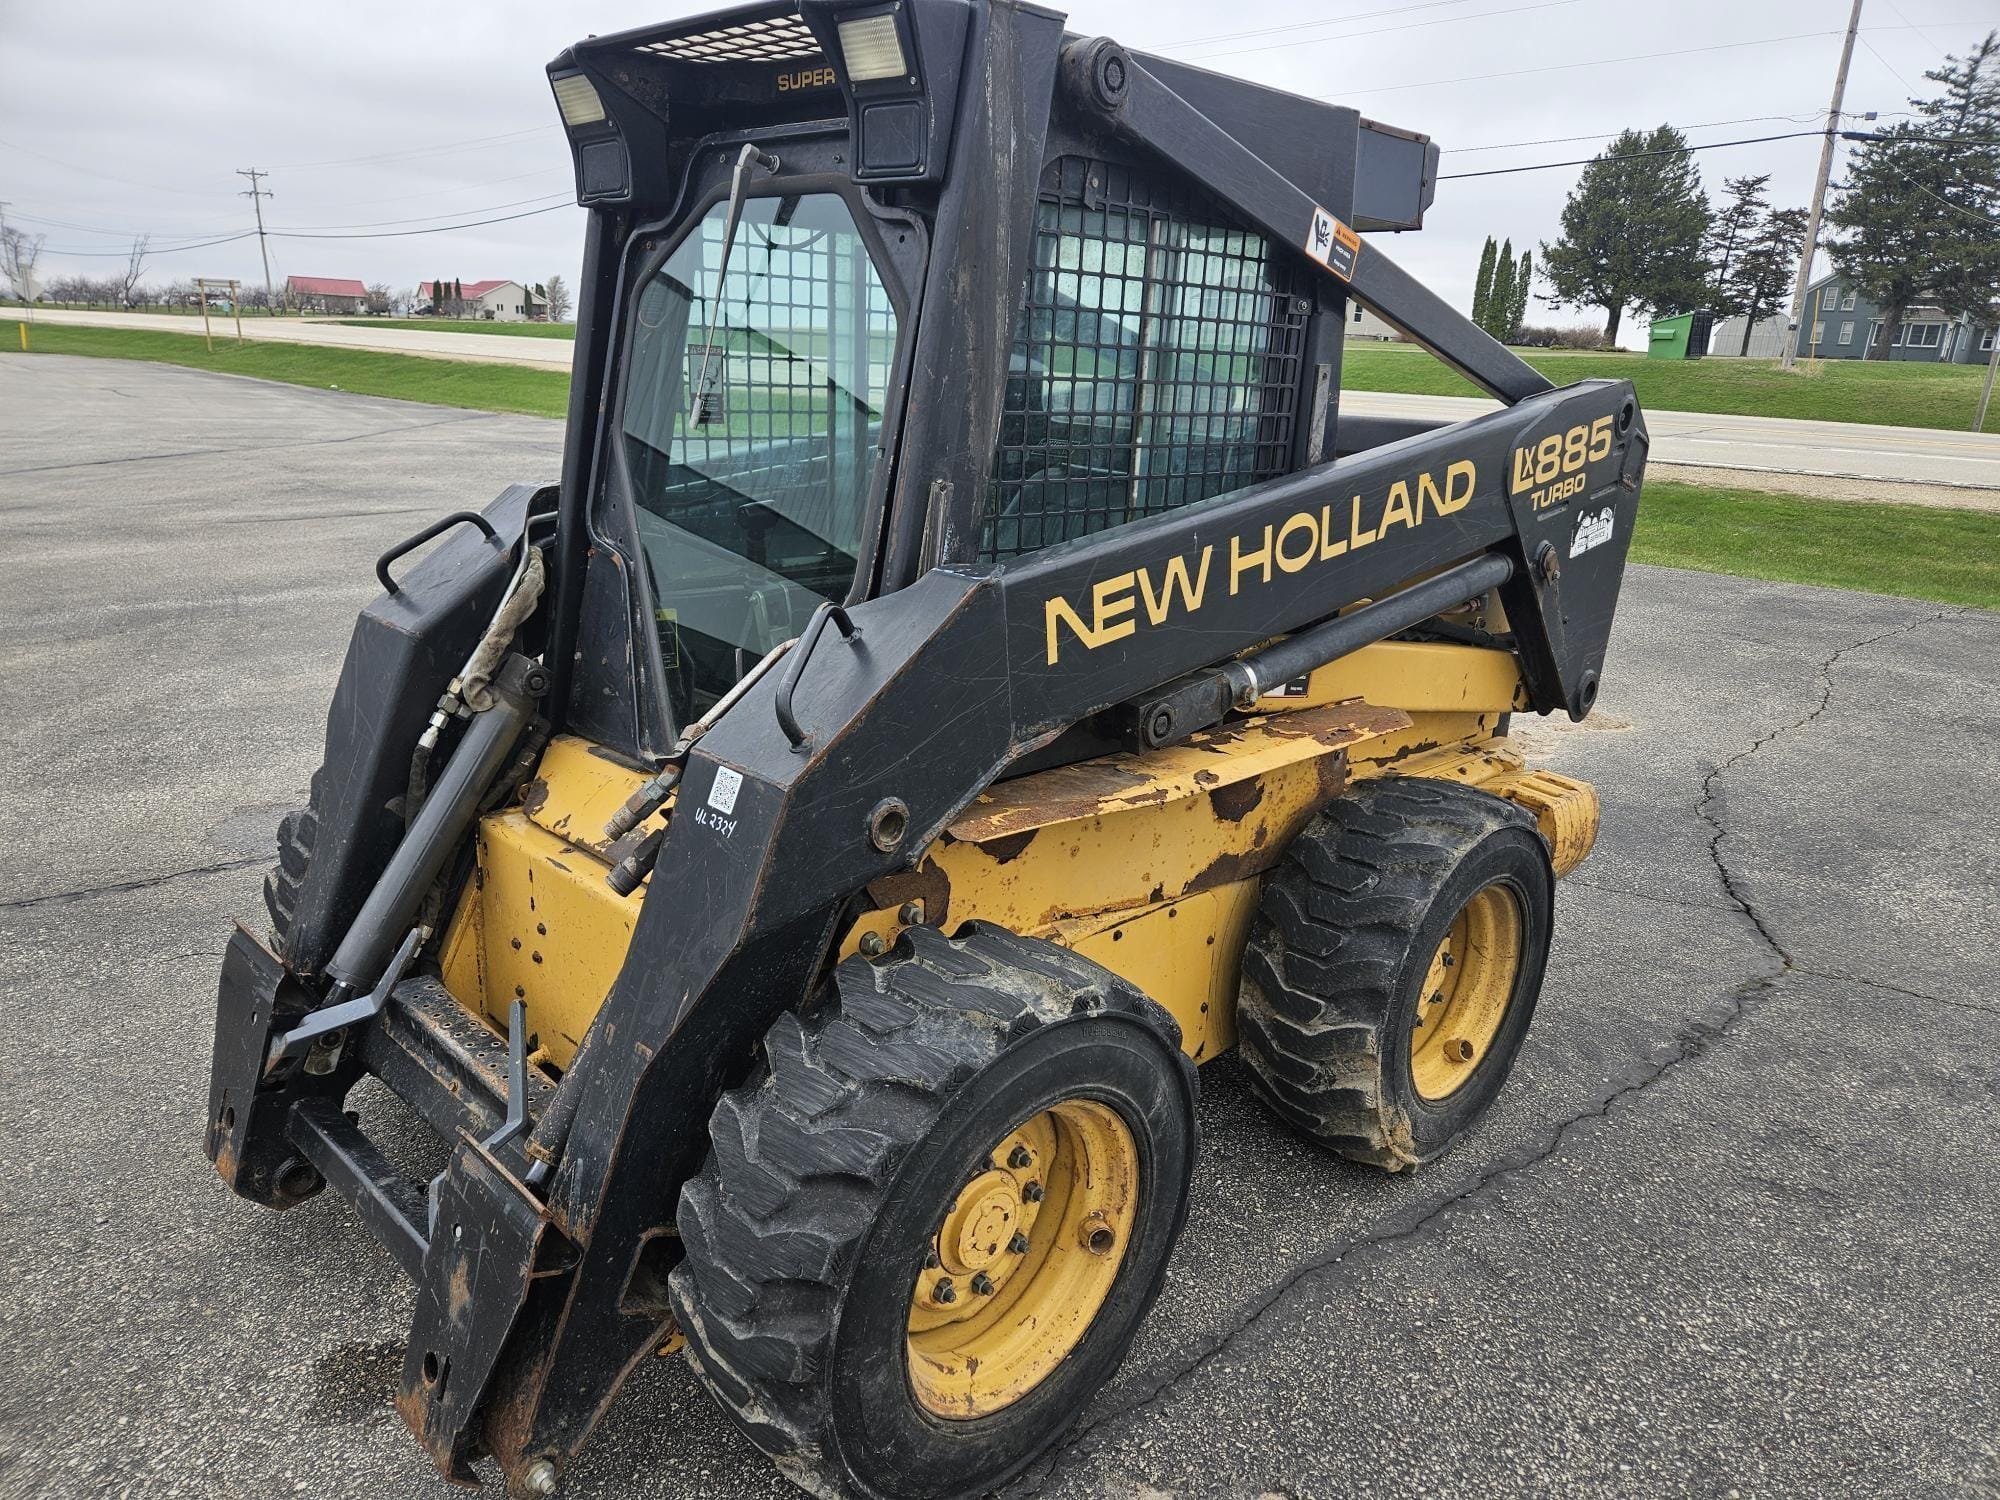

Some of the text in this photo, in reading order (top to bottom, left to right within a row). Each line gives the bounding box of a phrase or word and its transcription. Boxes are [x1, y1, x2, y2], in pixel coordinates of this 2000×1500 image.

[777, 67, 836, 91] SUPER
[1512, 414, 1613, 495] LX885
[1531, 472, 1586, 512] TURBO
[1045, 459, 1476, 666] NEW HOLLAND
